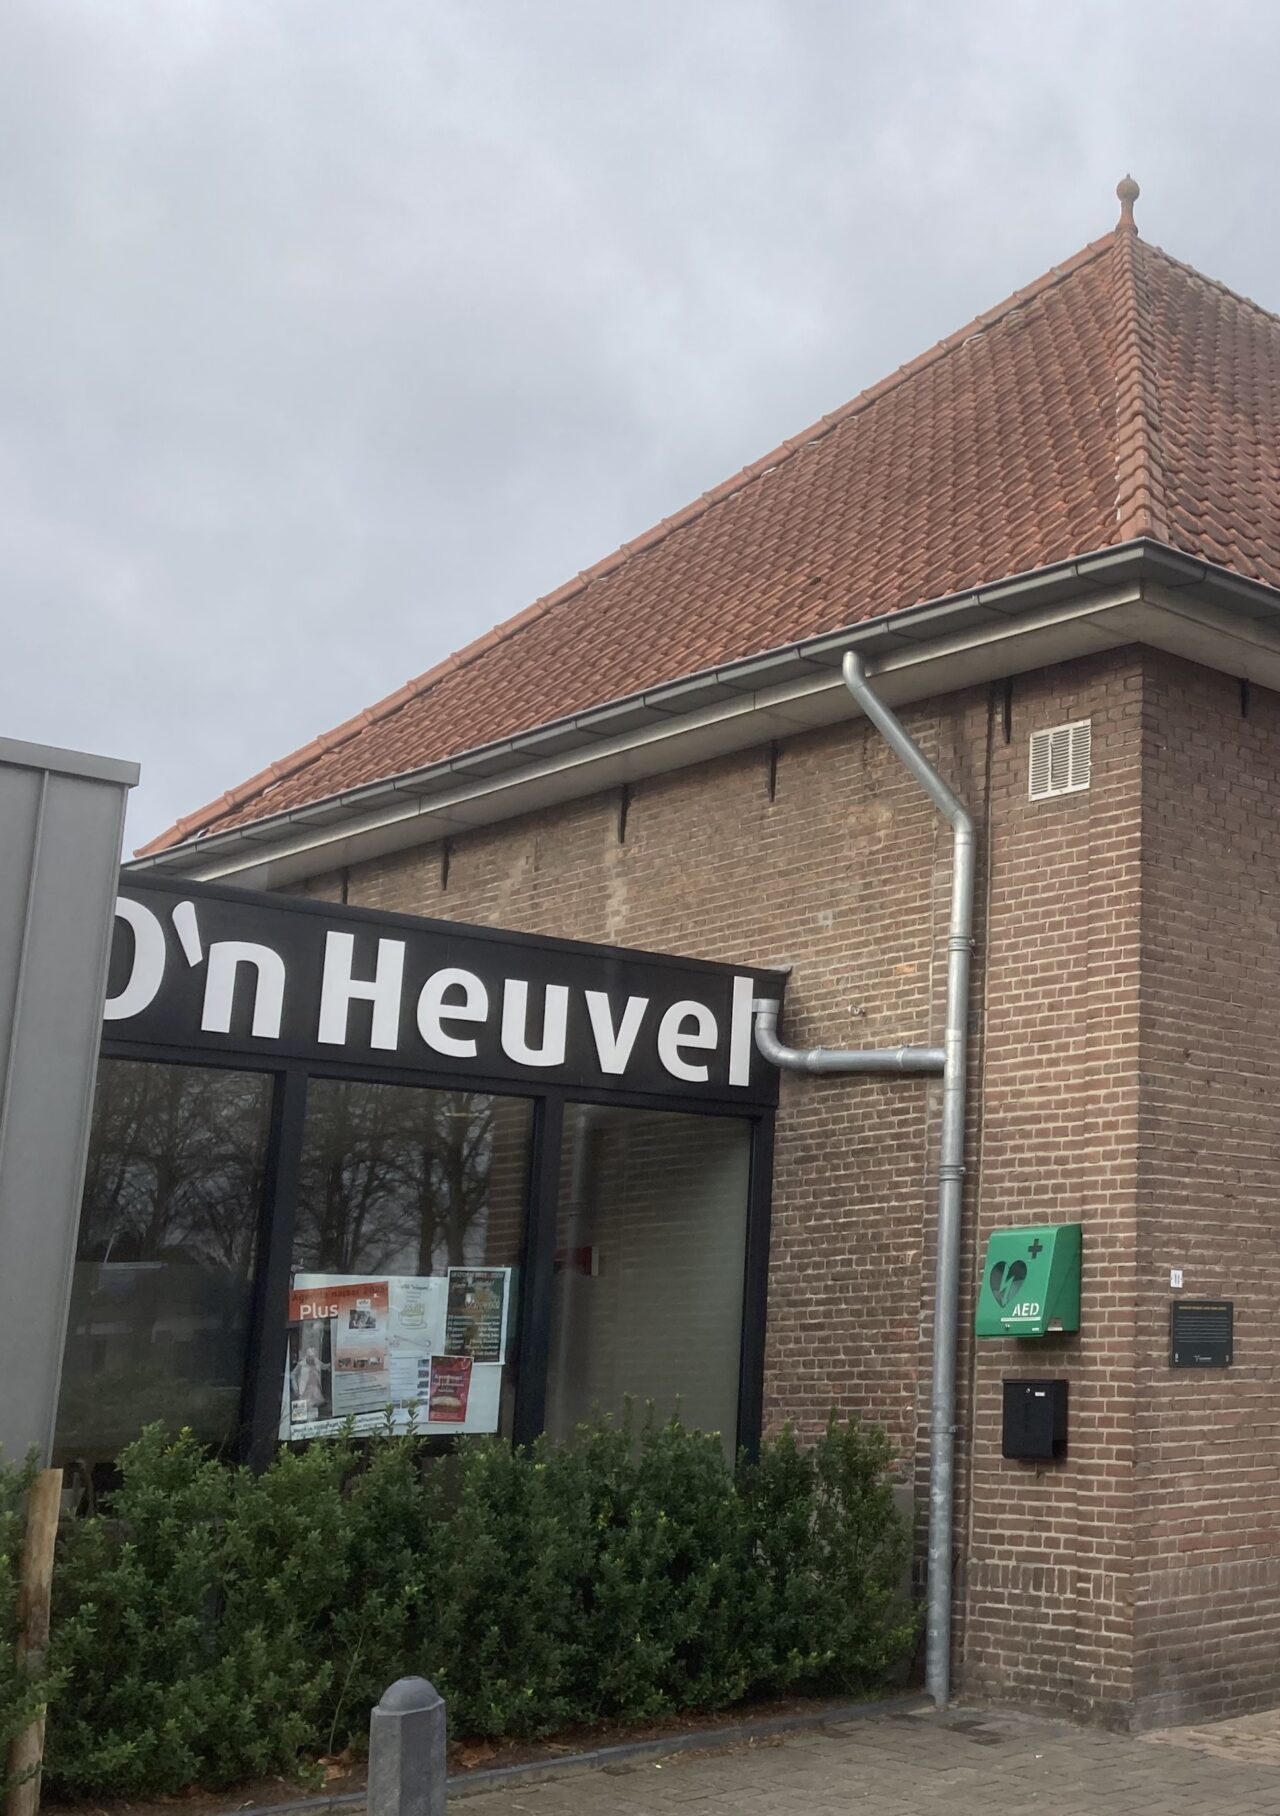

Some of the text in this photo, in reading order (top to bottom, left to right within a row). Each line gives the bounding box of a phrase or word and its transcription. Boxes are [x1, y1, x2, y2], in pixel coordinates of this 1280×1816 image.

[318, 930, 754, 1087] Heuvel
[300, 1302, 338, 1320] Plus
[1012, 1302, 1040, 1317] AED
